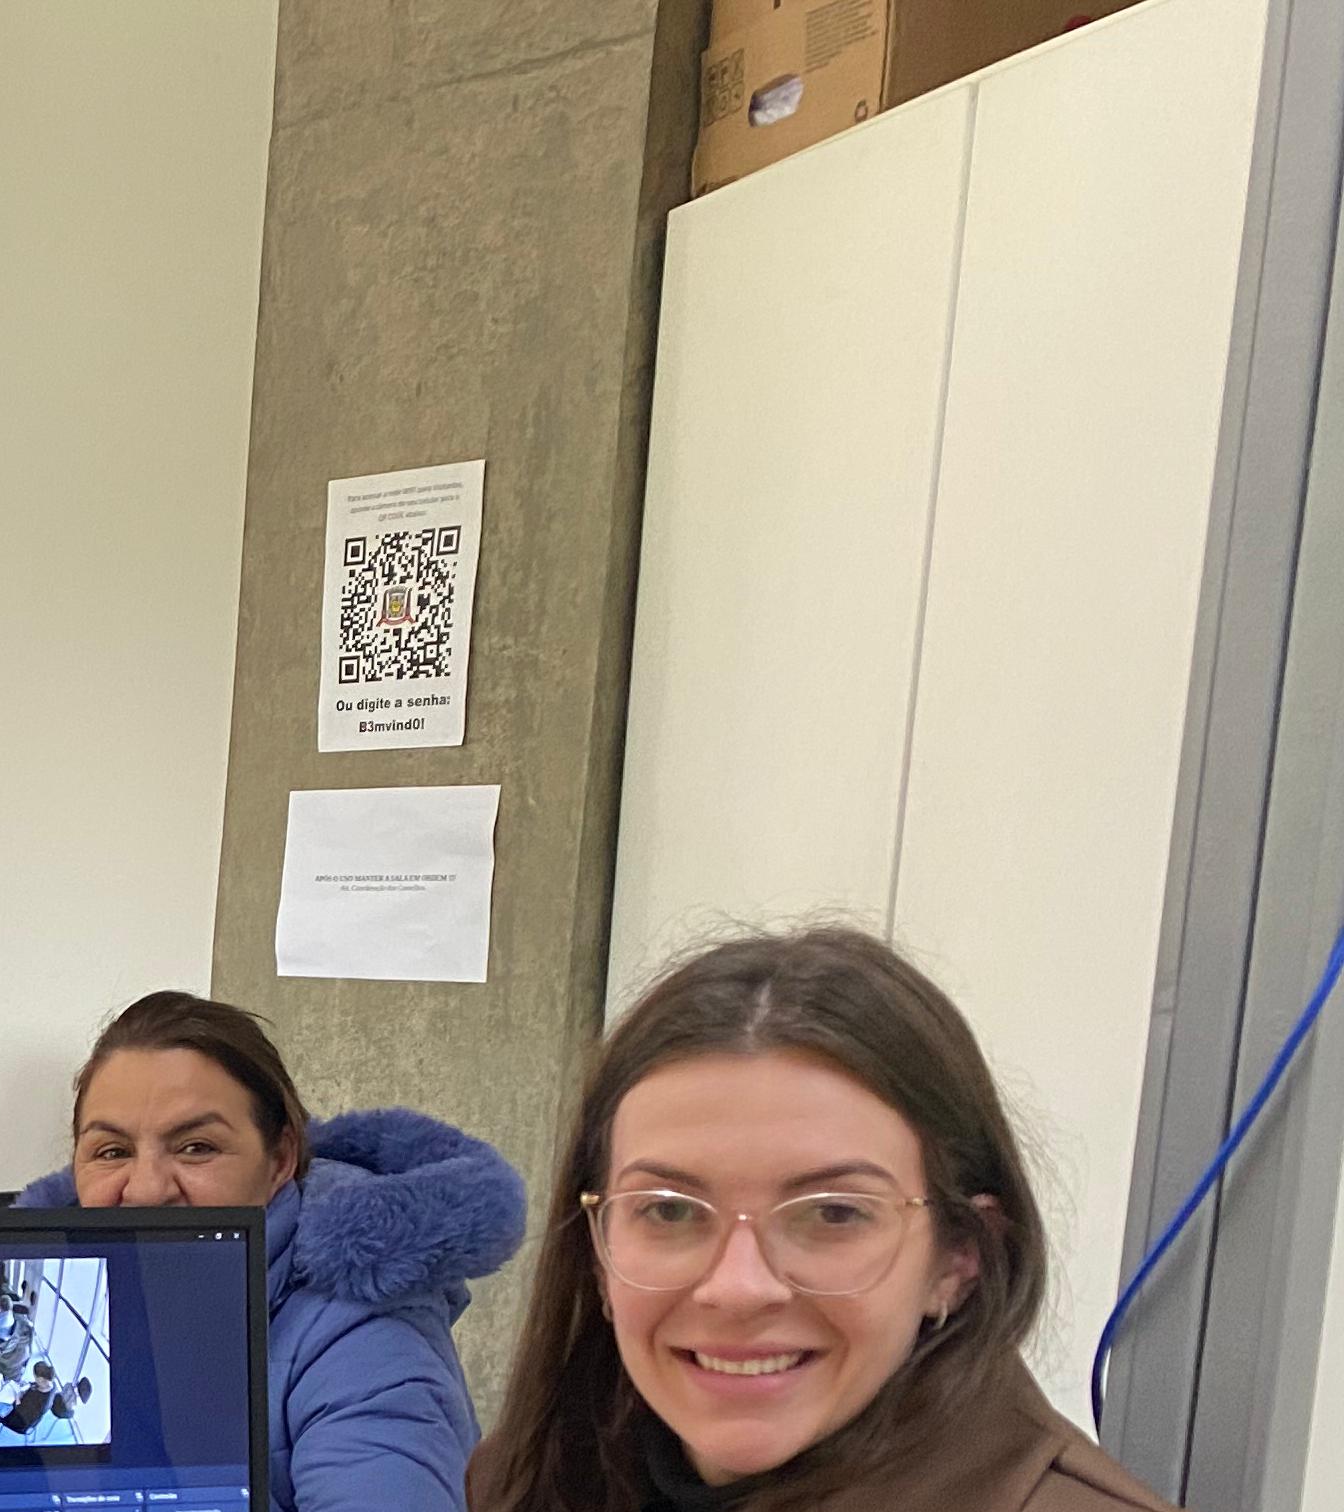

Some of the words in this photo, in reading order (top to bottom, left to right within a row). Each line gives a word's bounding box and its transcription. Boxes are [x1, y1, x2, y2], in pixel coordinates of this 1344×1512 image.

[336, 699, 353, 711] Ou
[356, 697, 391, 712] digite
[394, 698, 403, 708] a
[407, 694, 451, 708] senha:
